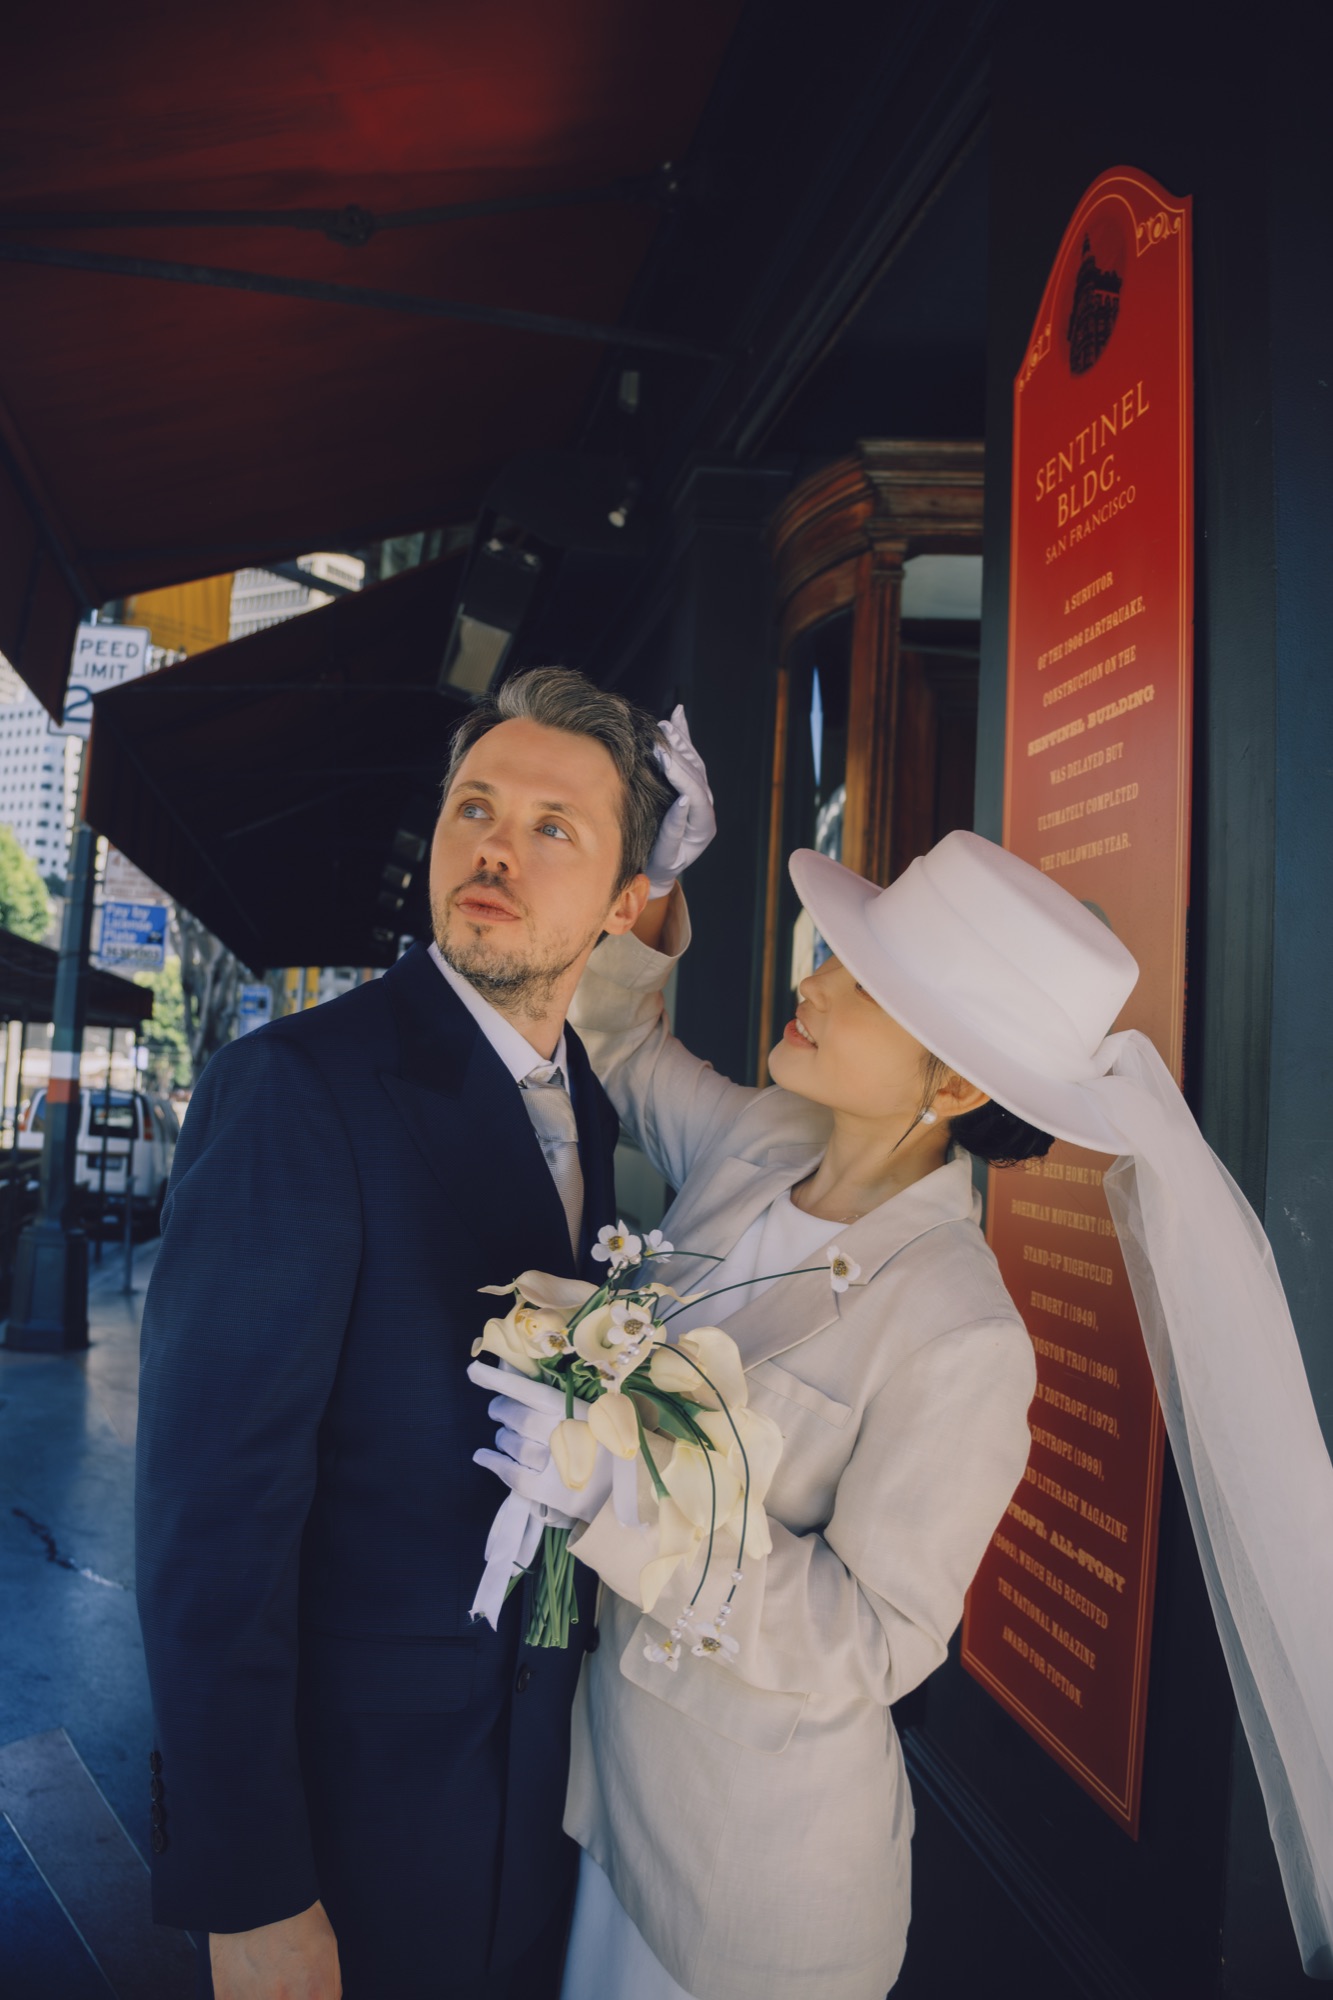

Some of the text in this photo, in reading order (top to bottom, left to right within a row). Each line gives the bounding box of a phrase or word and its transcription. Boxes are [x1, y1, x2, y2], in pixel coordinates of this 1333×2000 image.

[1035, 380, 1150, 502] SENTINEL
[1057, 454, 1121, 528] BLDG.
[1045, 485, 1136, 565] SAN FRANCISCO
[1064, 571, 1114, 615] A SURVIVOR
[79, 639, 139, 659] PEED
[1037, 596, 1146, 671] OF THE 1906 EARTHQUAKE,
[71, 663, 128, 679] IMIT
[1043, 645, 1136, 708] CONSTRUCTION ON THE
[64, 685, 92, 723] 2
[1028, 684, 1155, 757] SENTINEL BUILDING
[1050, 768, 1066, 785] WAS
[1067, 750, 1104, 779] DELAYED
[1037, 782, 1139, 831] ULTIMATELY COMPLETED
[1040, 832, 1131, 872] THE FOLLOWING YEAR.
[1043, 1162, 1065, 1180] BEEN
[1065, 1166, 1089, 1185] HOME
[1090, 1169, 1102, 1187] TO
[1011, 1199, 1050, 1222] BOHEMIAN
[1051, 1207, 1096, 1233] MOVEMENT
[1023, 1245, 1113, 1286] STAND-UP NIGHTCLUB
[1031, 1290, 1063, 1319] HUNGRY
[1031, 1335, 1120, 1390] NGSTON TRIO (1960),
[1044, 1385, 1088, 1421] ZOETROPE
[1088, 1407, 1120, 1440] (1972),
[1031, 1425, 1073, 1461] ZOETROPE
[1024, 1466, 1128, 1543] ND LITERARY MAGAZINE
[1007, 1500, 1126, 1594] TROPE: ALL-STORY
[1018, 1549, 1045, 1582] WHICH
[1045, 1571, 1063, 1596] HAS
[1063, 1583, 1109, 1630] RECEIVED
[997, 1576, 1096, 1670] THE NATIONAL MAGAZINE
[1002, 1625, 1083, 1708] AWARD FOR FICTION.
